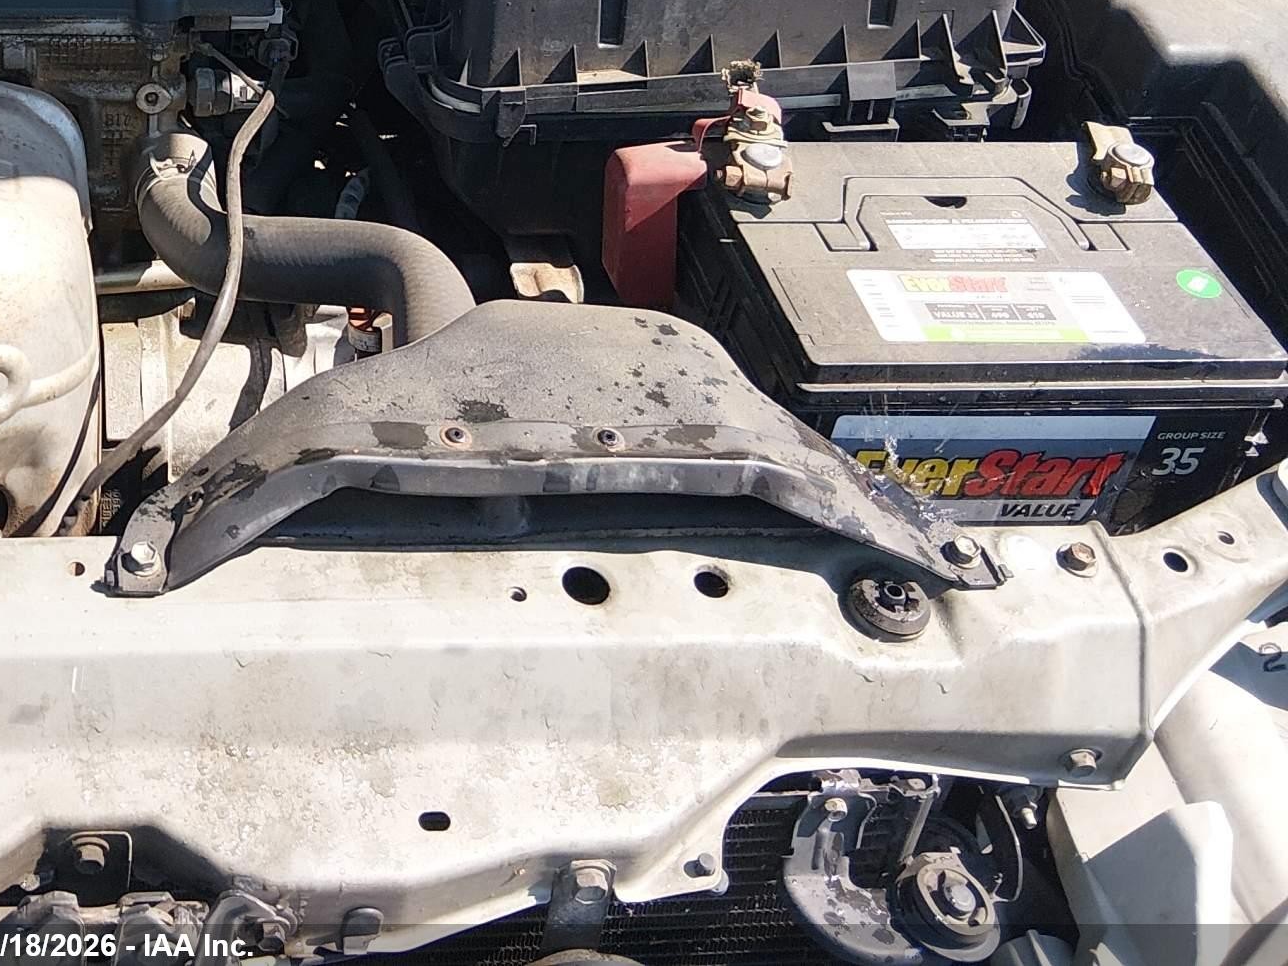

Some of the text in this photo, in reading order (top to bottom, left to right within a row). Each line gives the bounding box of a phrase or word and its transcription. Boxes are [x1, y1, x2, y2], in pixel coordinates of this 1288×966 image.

[1157, 431, 1226, 440] GROUP SIZE
[1151, 447, 1206, 475] 35
[999, 502, 1082, 519] VALUE
